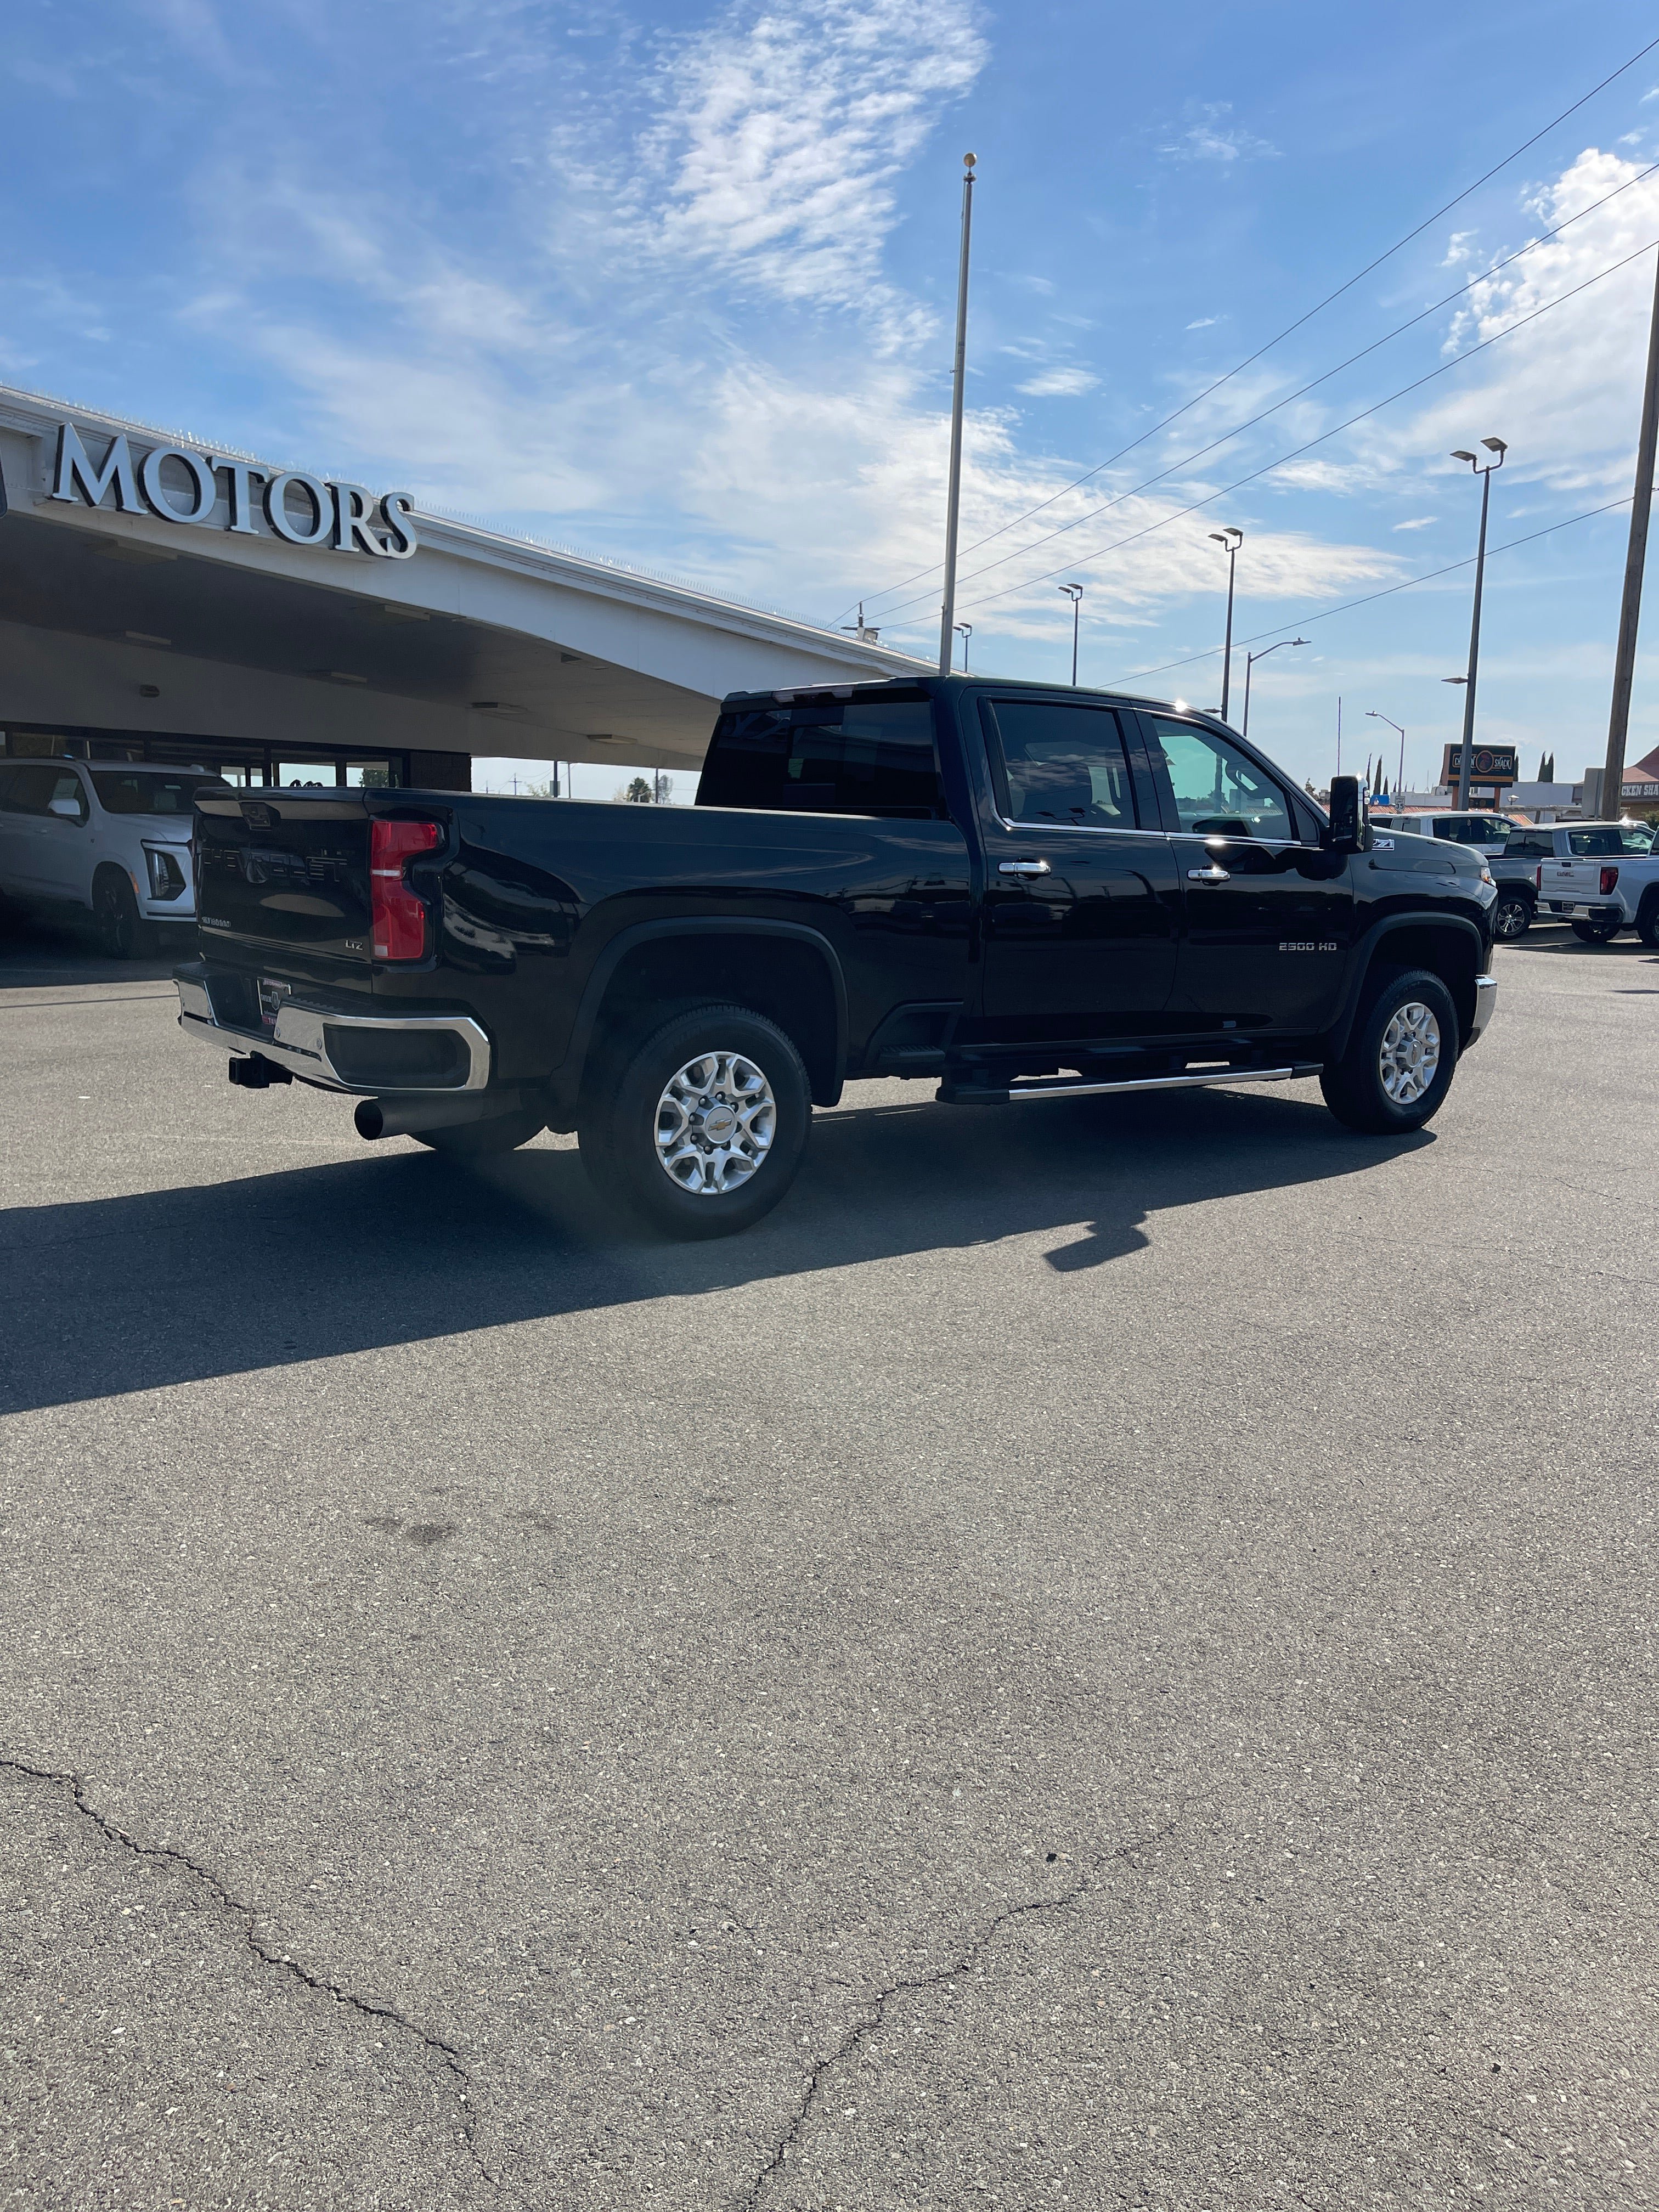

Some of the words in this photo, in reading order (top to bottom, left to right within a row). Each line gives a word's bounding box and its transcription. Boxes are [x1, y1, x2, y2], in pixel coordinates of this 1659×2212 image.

[52, 422, 417, 559] MOTORS
[1494, 757, 1511, 770] SHACK
[1621, 785, 1642, 796] CKEN
[1644, 784, 1658, 795] SHA
[345, 940, 363, 950] LTZ
[1279, 943, 1315, 951] 2500
[1318, 943, 1337, 951] HD
